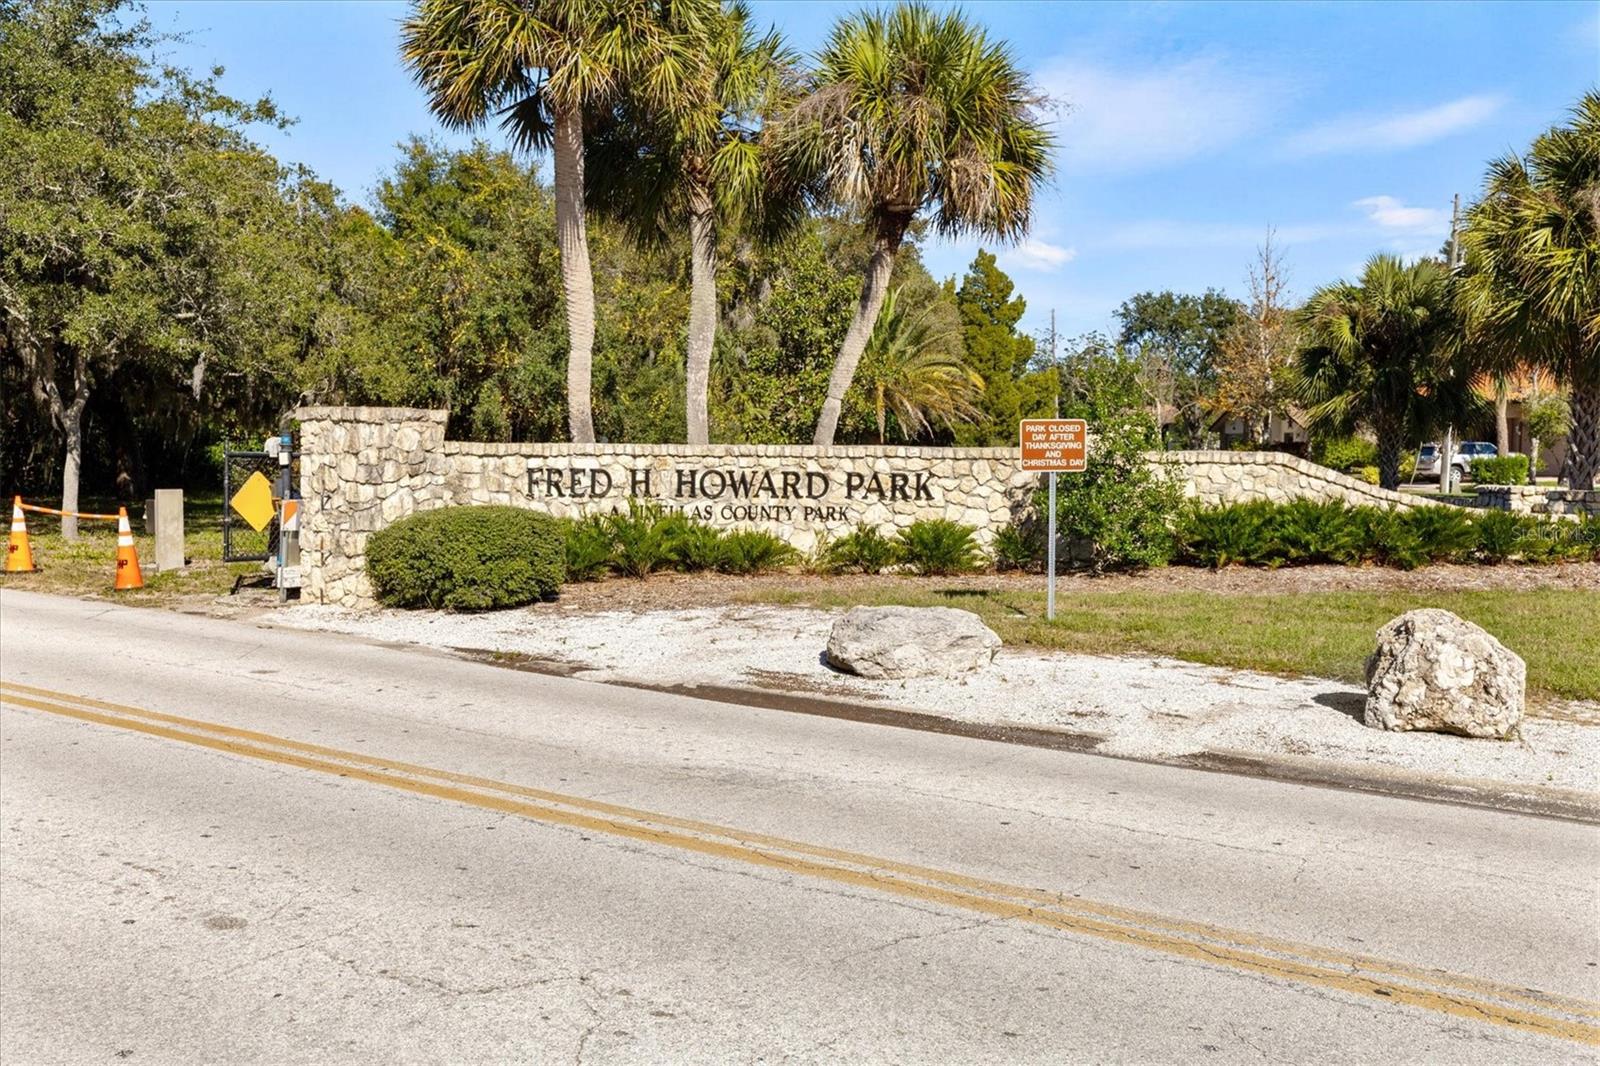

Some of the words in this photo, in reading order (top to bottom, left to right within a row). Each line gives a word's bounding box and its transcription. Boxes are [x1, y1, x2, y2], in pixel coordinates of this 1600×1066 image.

[526, 468, 613, 499] FRED
[630, 468, 661, 499] H.
[675, 469, 831, 500] HOWARD
[845, 471, 935, 502] PARK
[720, 505, 797, 522] COUNTY
[803, 506, 850, 523] PARK
